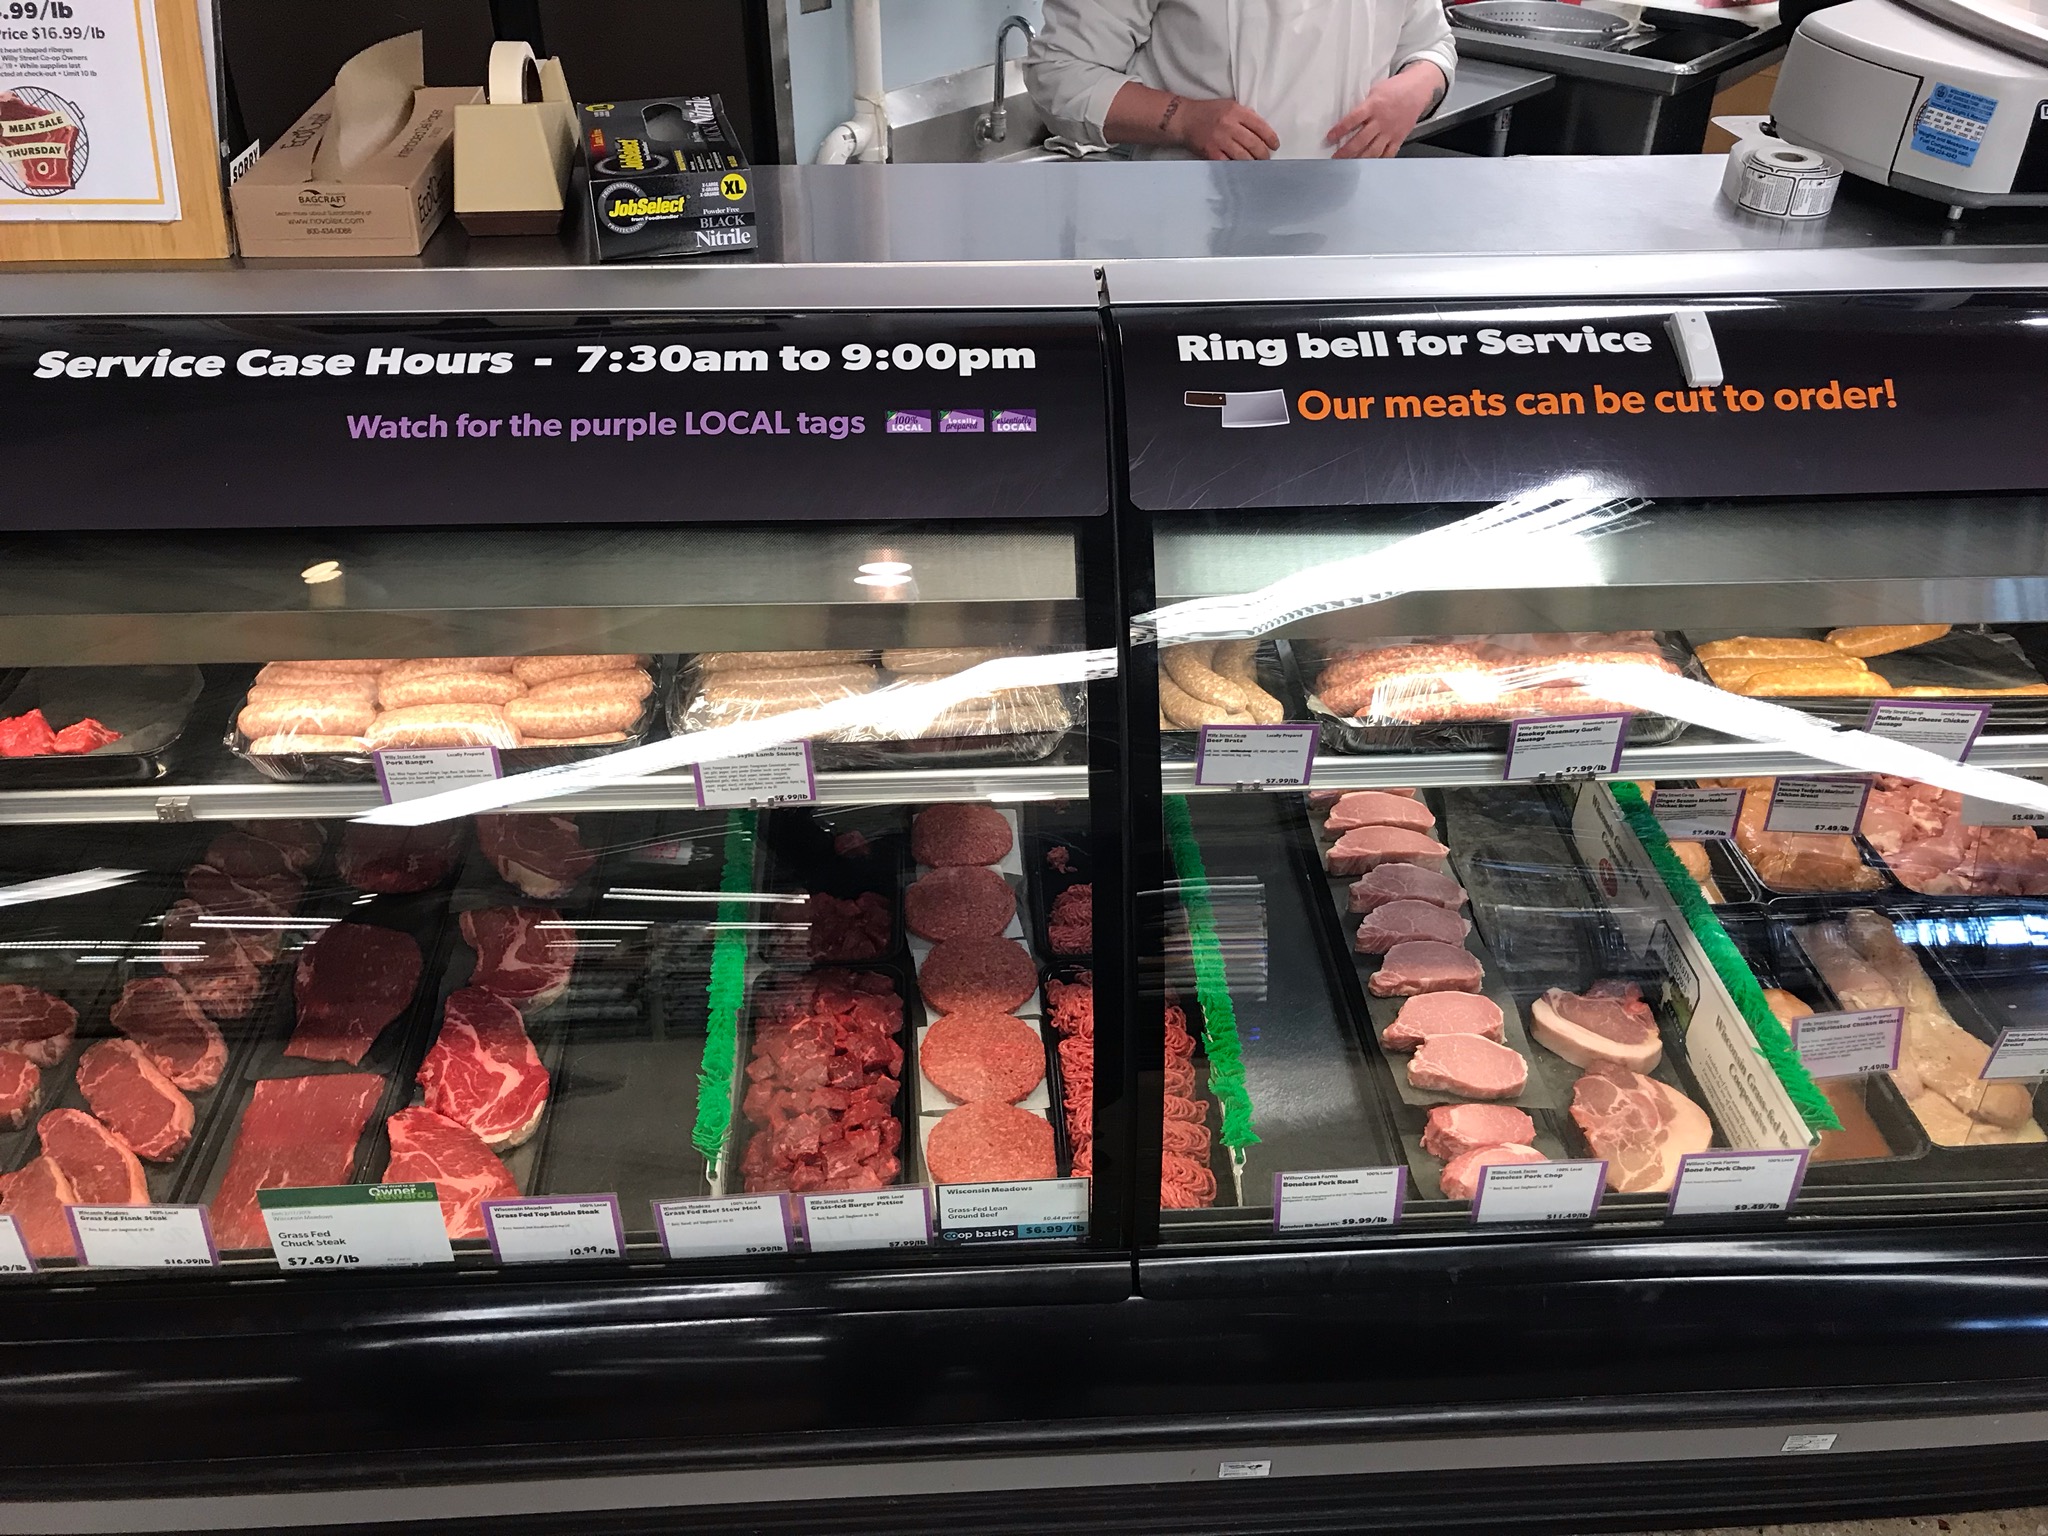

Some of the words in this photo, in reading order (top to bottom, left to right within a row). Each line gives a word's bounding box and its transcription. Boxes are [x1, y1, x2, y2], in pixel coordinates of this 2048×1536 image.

[0, 0, 73, 20] .99/lb
[0, 28, 28, 40] rice
[32, 26, 105, 40] $16.99/lb
[9, 122, 36, 133] MEAT
[38, 116, 63, 129] SALE
[6, 147, 62, 158] THURSDAY
[233, 147, 259, 183] SORRY
[602, 181, 640, 198] PROFESSIONAL
[723, 180, 744, 195] XL
[608, 195, 685, 217] JobSelect
[607, 222, 643, 233] PROTECTION
[700, 215, 745, 228] BLACK
[695, 229, 751, 248] Nitrile
[1178, 334, 1289, 365] Ring
[1299, 332, 1391, 360] bell
[1397, 330, 1470, 357] for
[1477, 327, 1653, 356] Service
[34, 348, 225, 378] Service
[236, 349, 355, 377] Case
[365, 348, 514, 376] Hours
[576, 344, 770, 373] 7:30am
[780, 344, 830, 371] to
[841, 342, 1036, 376] 9:00pm
[1297, 390, 1375, 421] Our
[1384, 390, 1508, 419] meats
[1516, 391, 1586, 416] can
[1595, 387, 1646, 415] be
[1655, 386, 1718, 414] cut
[1723, 385, 1767, 412] to
[1773, 379, 1898, 411] order!
[347, 415, 448, 439] Watch
[456, 413, 503, 437] for
[509, 413, 562, 437] the
[570, 410, 676, 442] purple
[685, 410, 790, 436] LOCAL
[796, 411, 865, 440] tags
[894, 416, 919, 424] 100%
[996, 416, 1032, 425] essentially
[946, 422, 978, 432] prepared
[1566, 764, 1607, 772] $7.99/lb
[1715, 1015, 1749, 1077] Wisconsin
[1746, 1073, 1782, 1131] Grass-fed
[1727, 1062, 1768, 1136] Cooperative
[369, 1187, 416, 1197] Owner
[375, 1190, 433, 1200] Rewards
[1734, 1202, 1780, 1210] $9.49/lb
[1342, 1217, 1388, 1225] $9.99/lb
[1026, 1225, 1063, 1234] $6.99
[1065, 1224, 1085, 1233] /lb
[317, 1238, 346, 1246] Steak
[570, 1246, 597, 1255] 10.99
[288, 1254, 359, 1266] $7.49/lb
